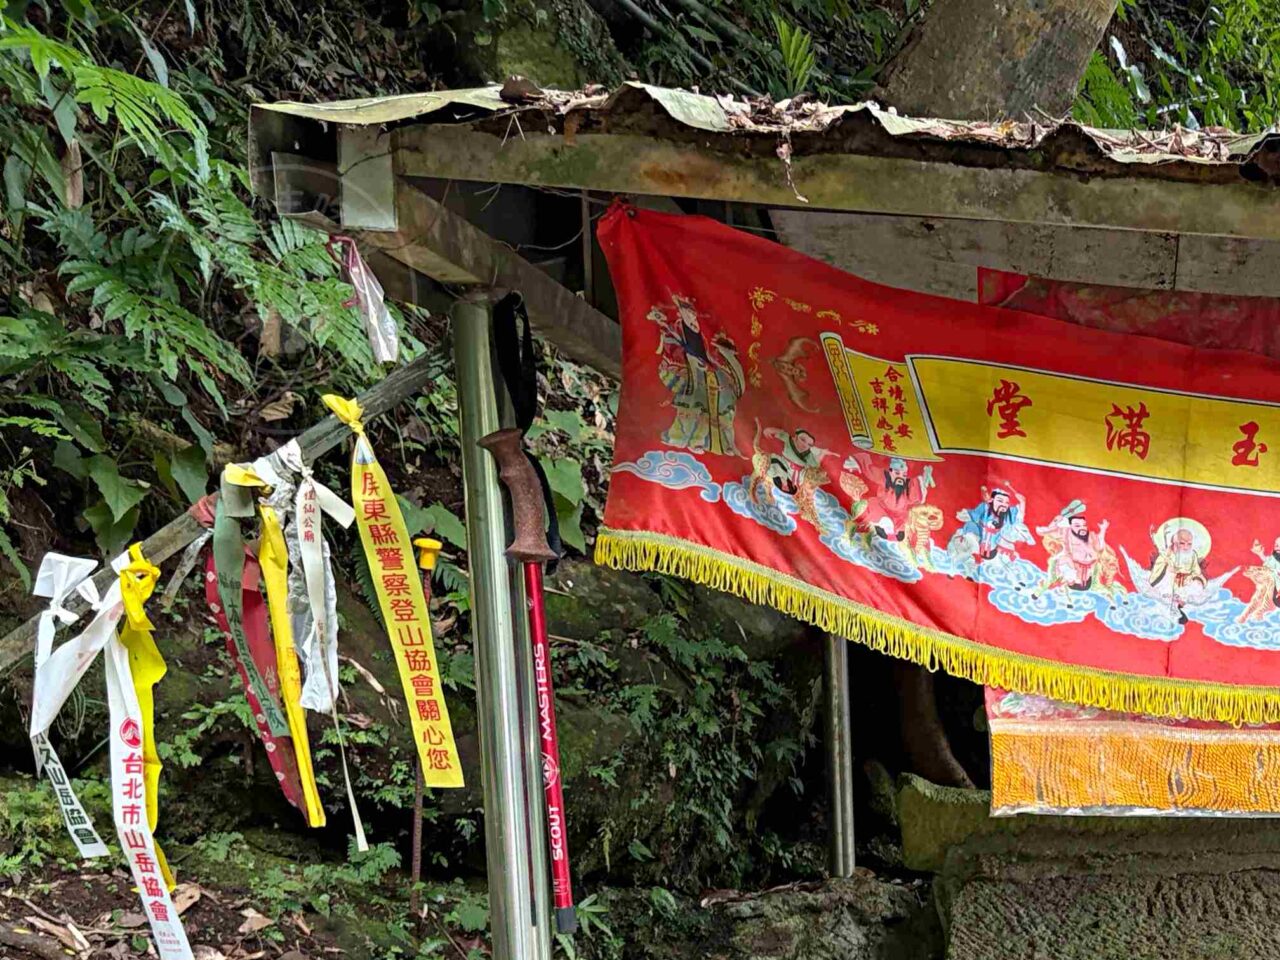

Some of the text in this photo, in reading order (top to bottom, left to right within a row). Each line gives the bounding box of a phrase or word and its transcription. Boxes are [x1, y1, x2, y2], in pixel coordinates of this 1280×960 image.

[361, 471, 453, 771] 屏東縣警察登山協會關心您
[533, 643, 553, 741] MASTERS
[121, 752, 170, 922] 台北市山岳協會
[549, 804, 564, 861] SCOUT
